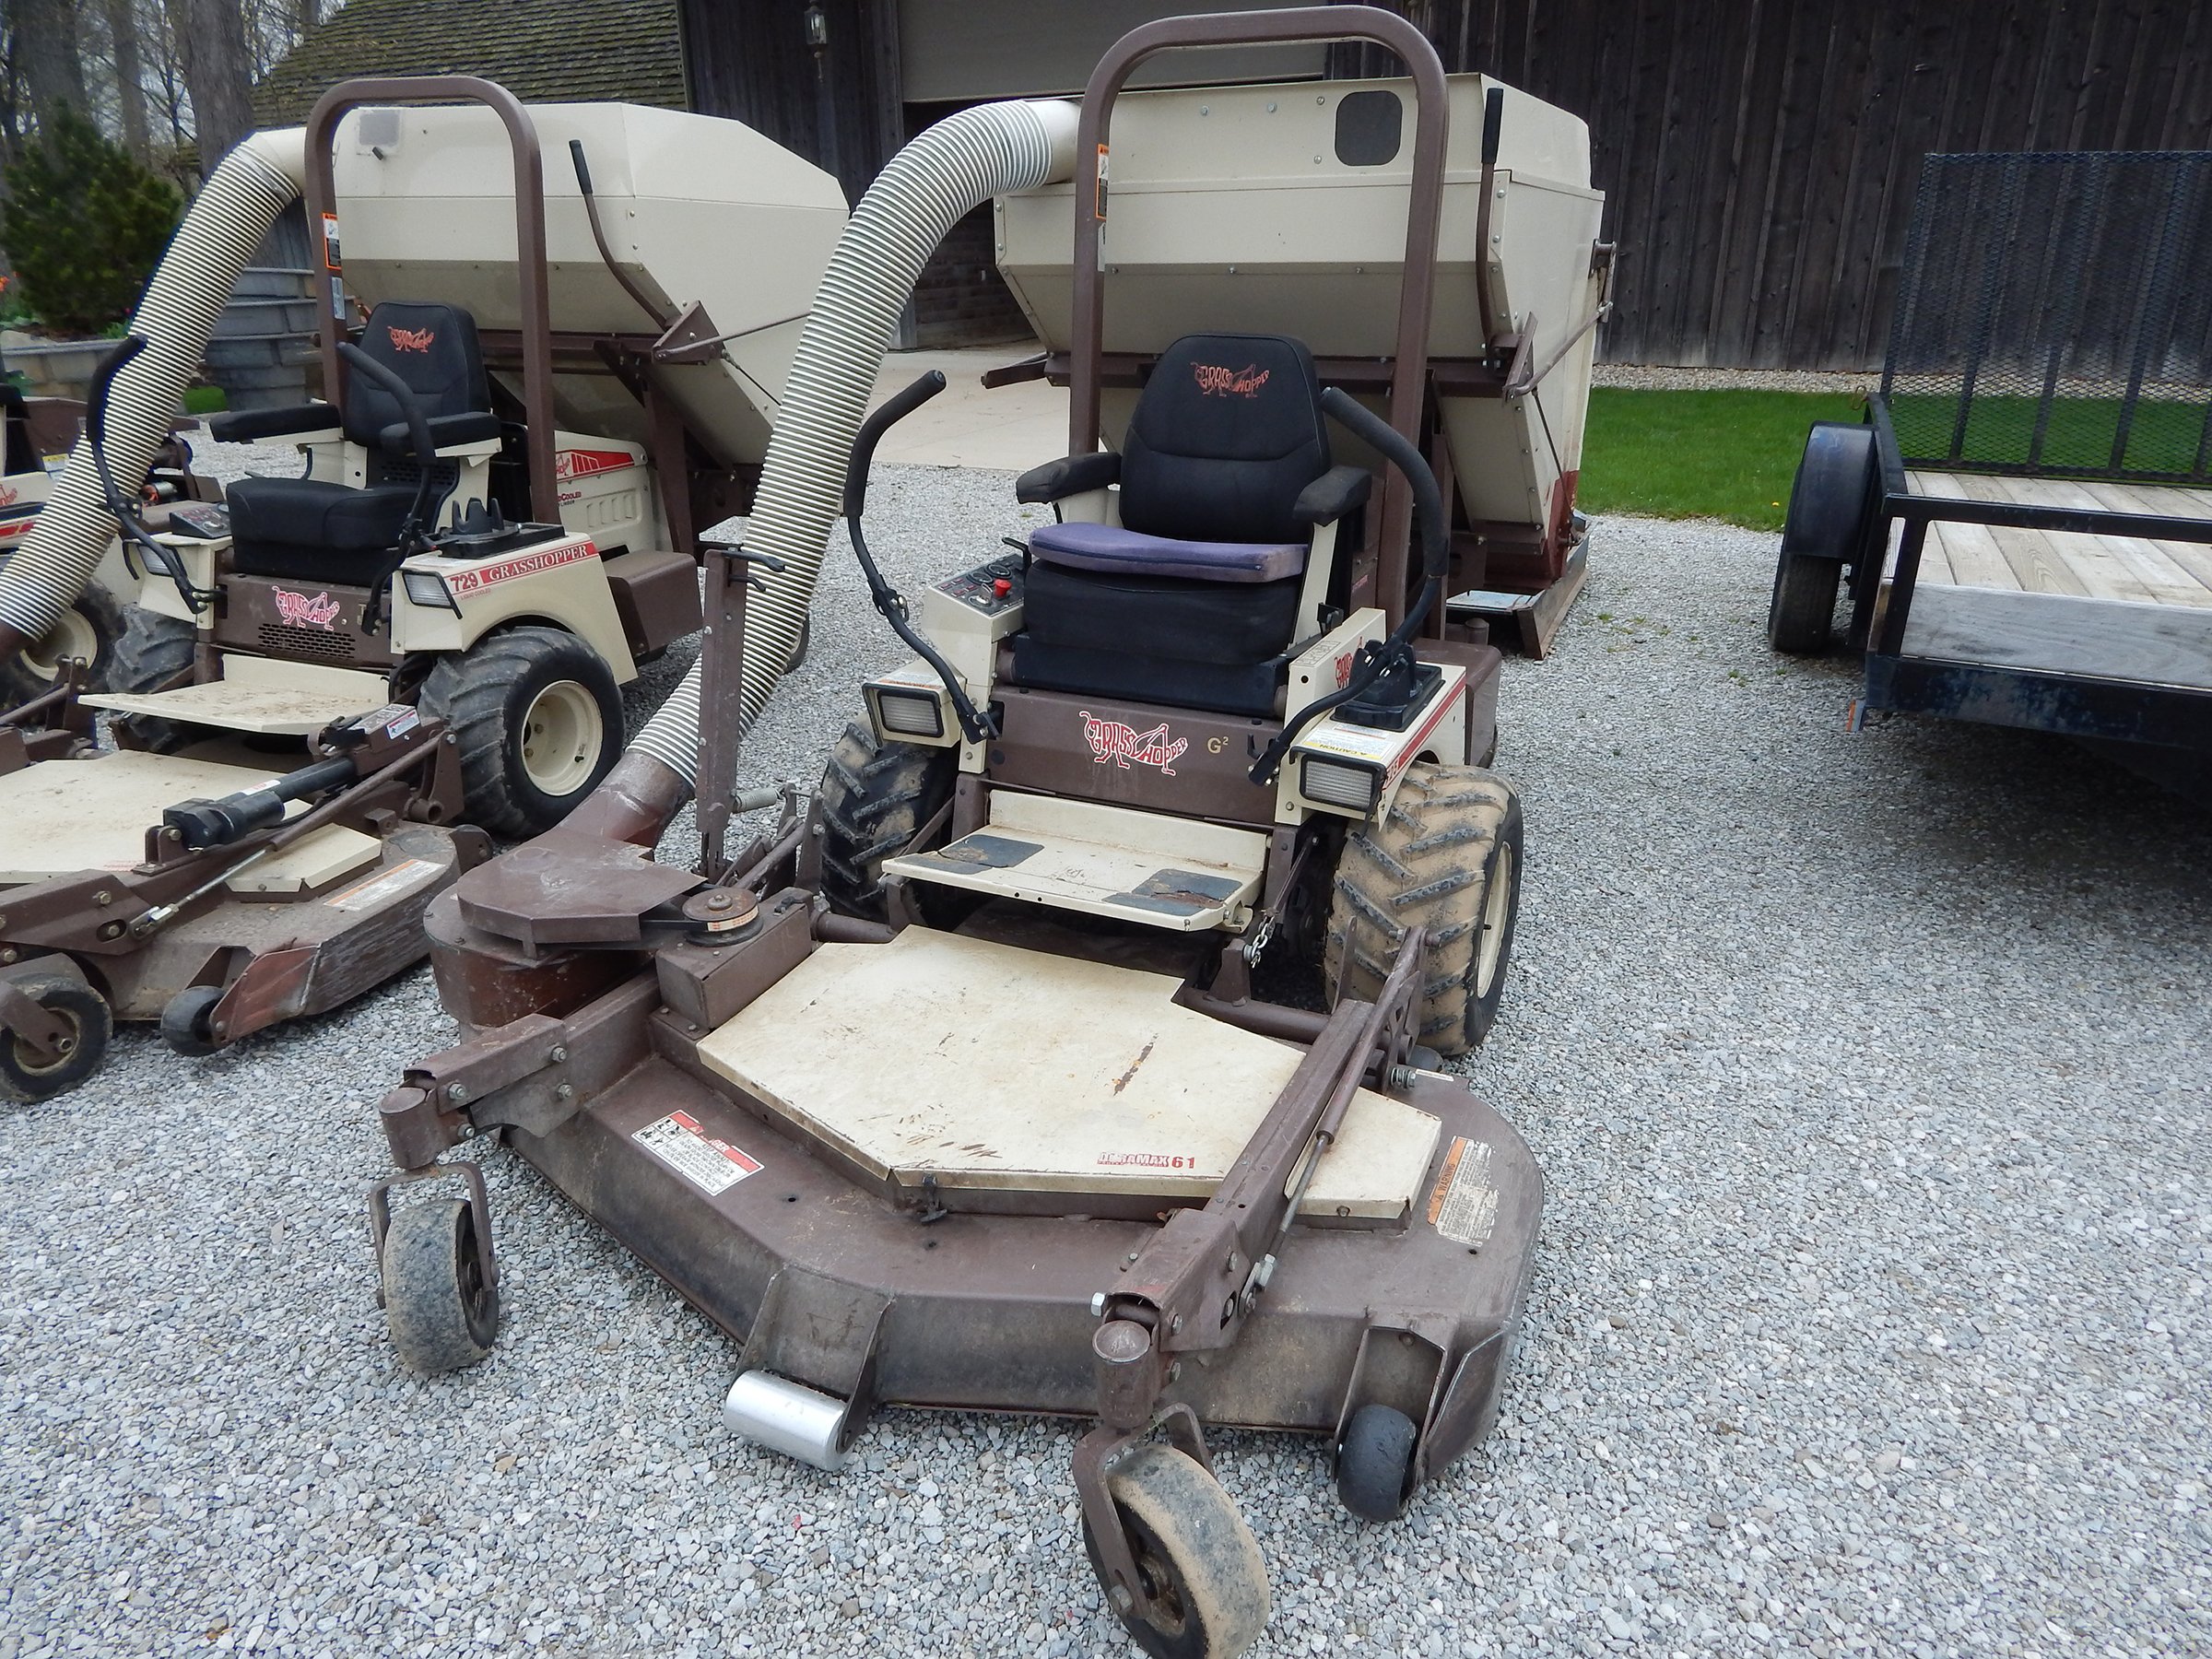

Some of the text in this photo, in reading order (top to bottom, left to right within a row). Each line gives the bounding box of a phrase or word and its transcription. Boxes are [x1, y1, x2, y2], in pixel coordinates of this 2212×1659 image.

[1195, 365, 1269, 394] GRASSHOPPER
[450, 544, 588, 592] 729 GRASSHOPPER
[1087, 717, 1188, 770] GRASSHOPPER
[1319, 744, 1358, 755] CAUTION
[1171, 1156, 1195, 1169] 61
[1438, 1162, 1456, 1192] WARNING
